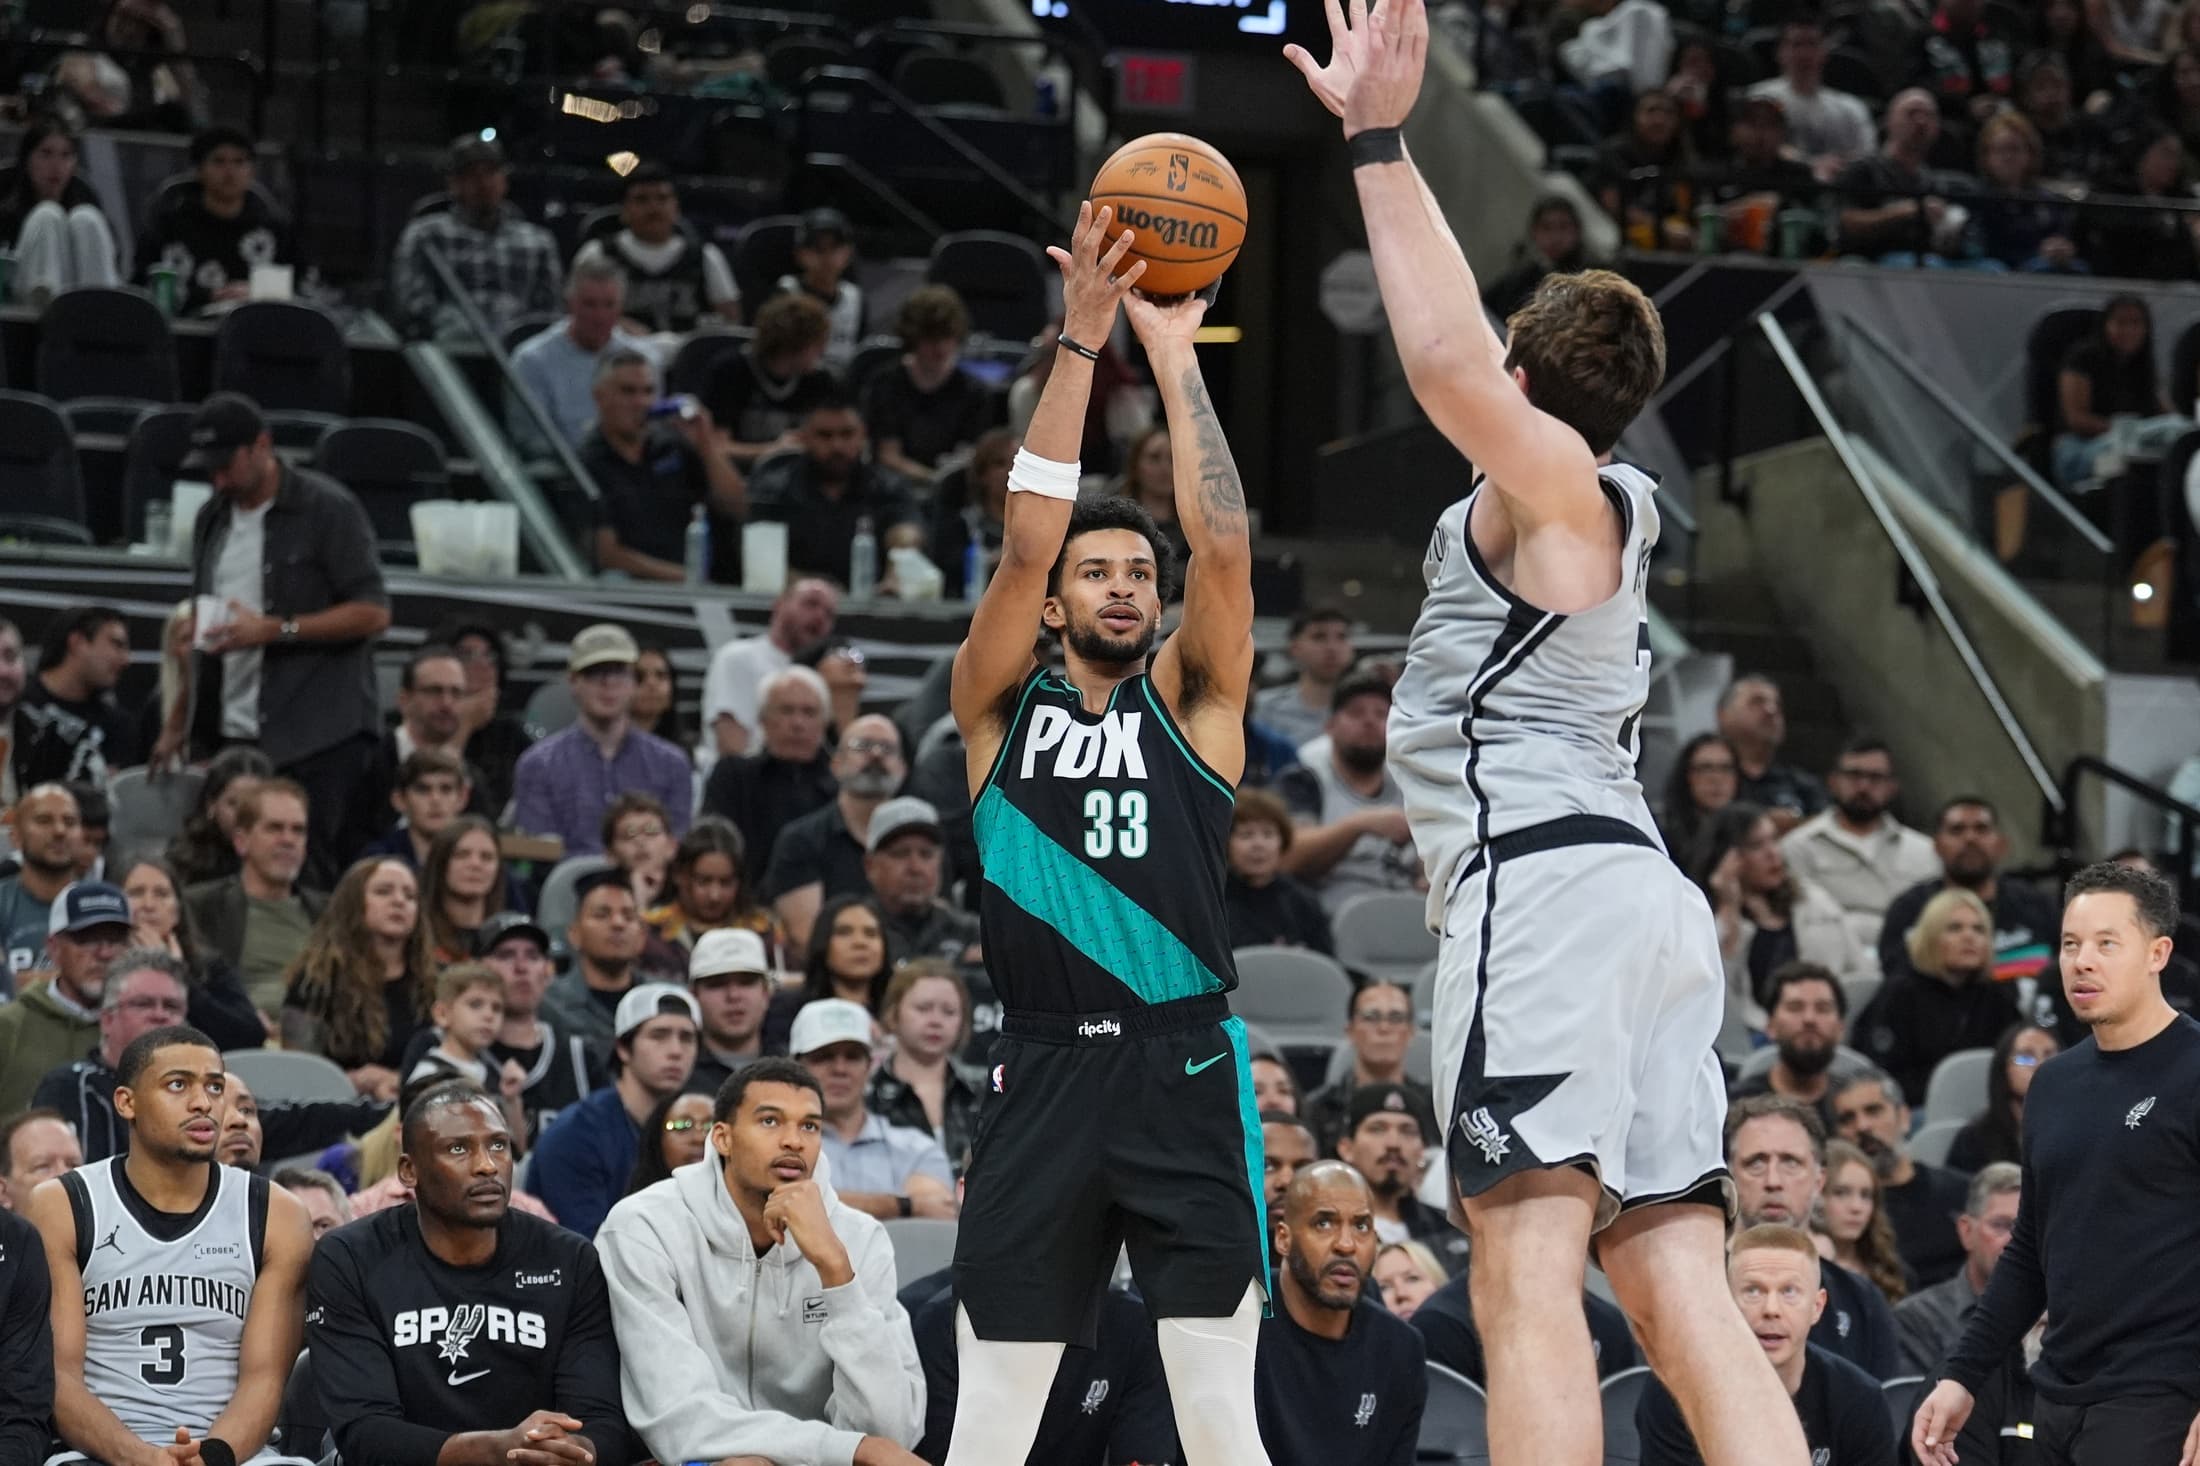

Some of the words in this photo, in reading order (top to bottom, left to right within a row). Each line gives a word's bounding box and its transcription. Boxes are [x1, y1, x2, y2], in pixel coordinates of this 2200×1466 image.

[1117, 203, 1219, 249] Wilson
[1020, 704, 1149, 780] PDX
[1083, 789, 1149, 859] 33
[1078, 1019, 1121, 1038] ripcity
[199, 1246, 236, 1256] LEDGER
[84, 1276, 132, 1317] SAN
[137, 1274, 246, 1321] ANTONIO
[520, 1273, 556, 1285] LEDGER
[139, 1323, 187, 1387] 3
[394, 1304, 547, 1364] SPURS
